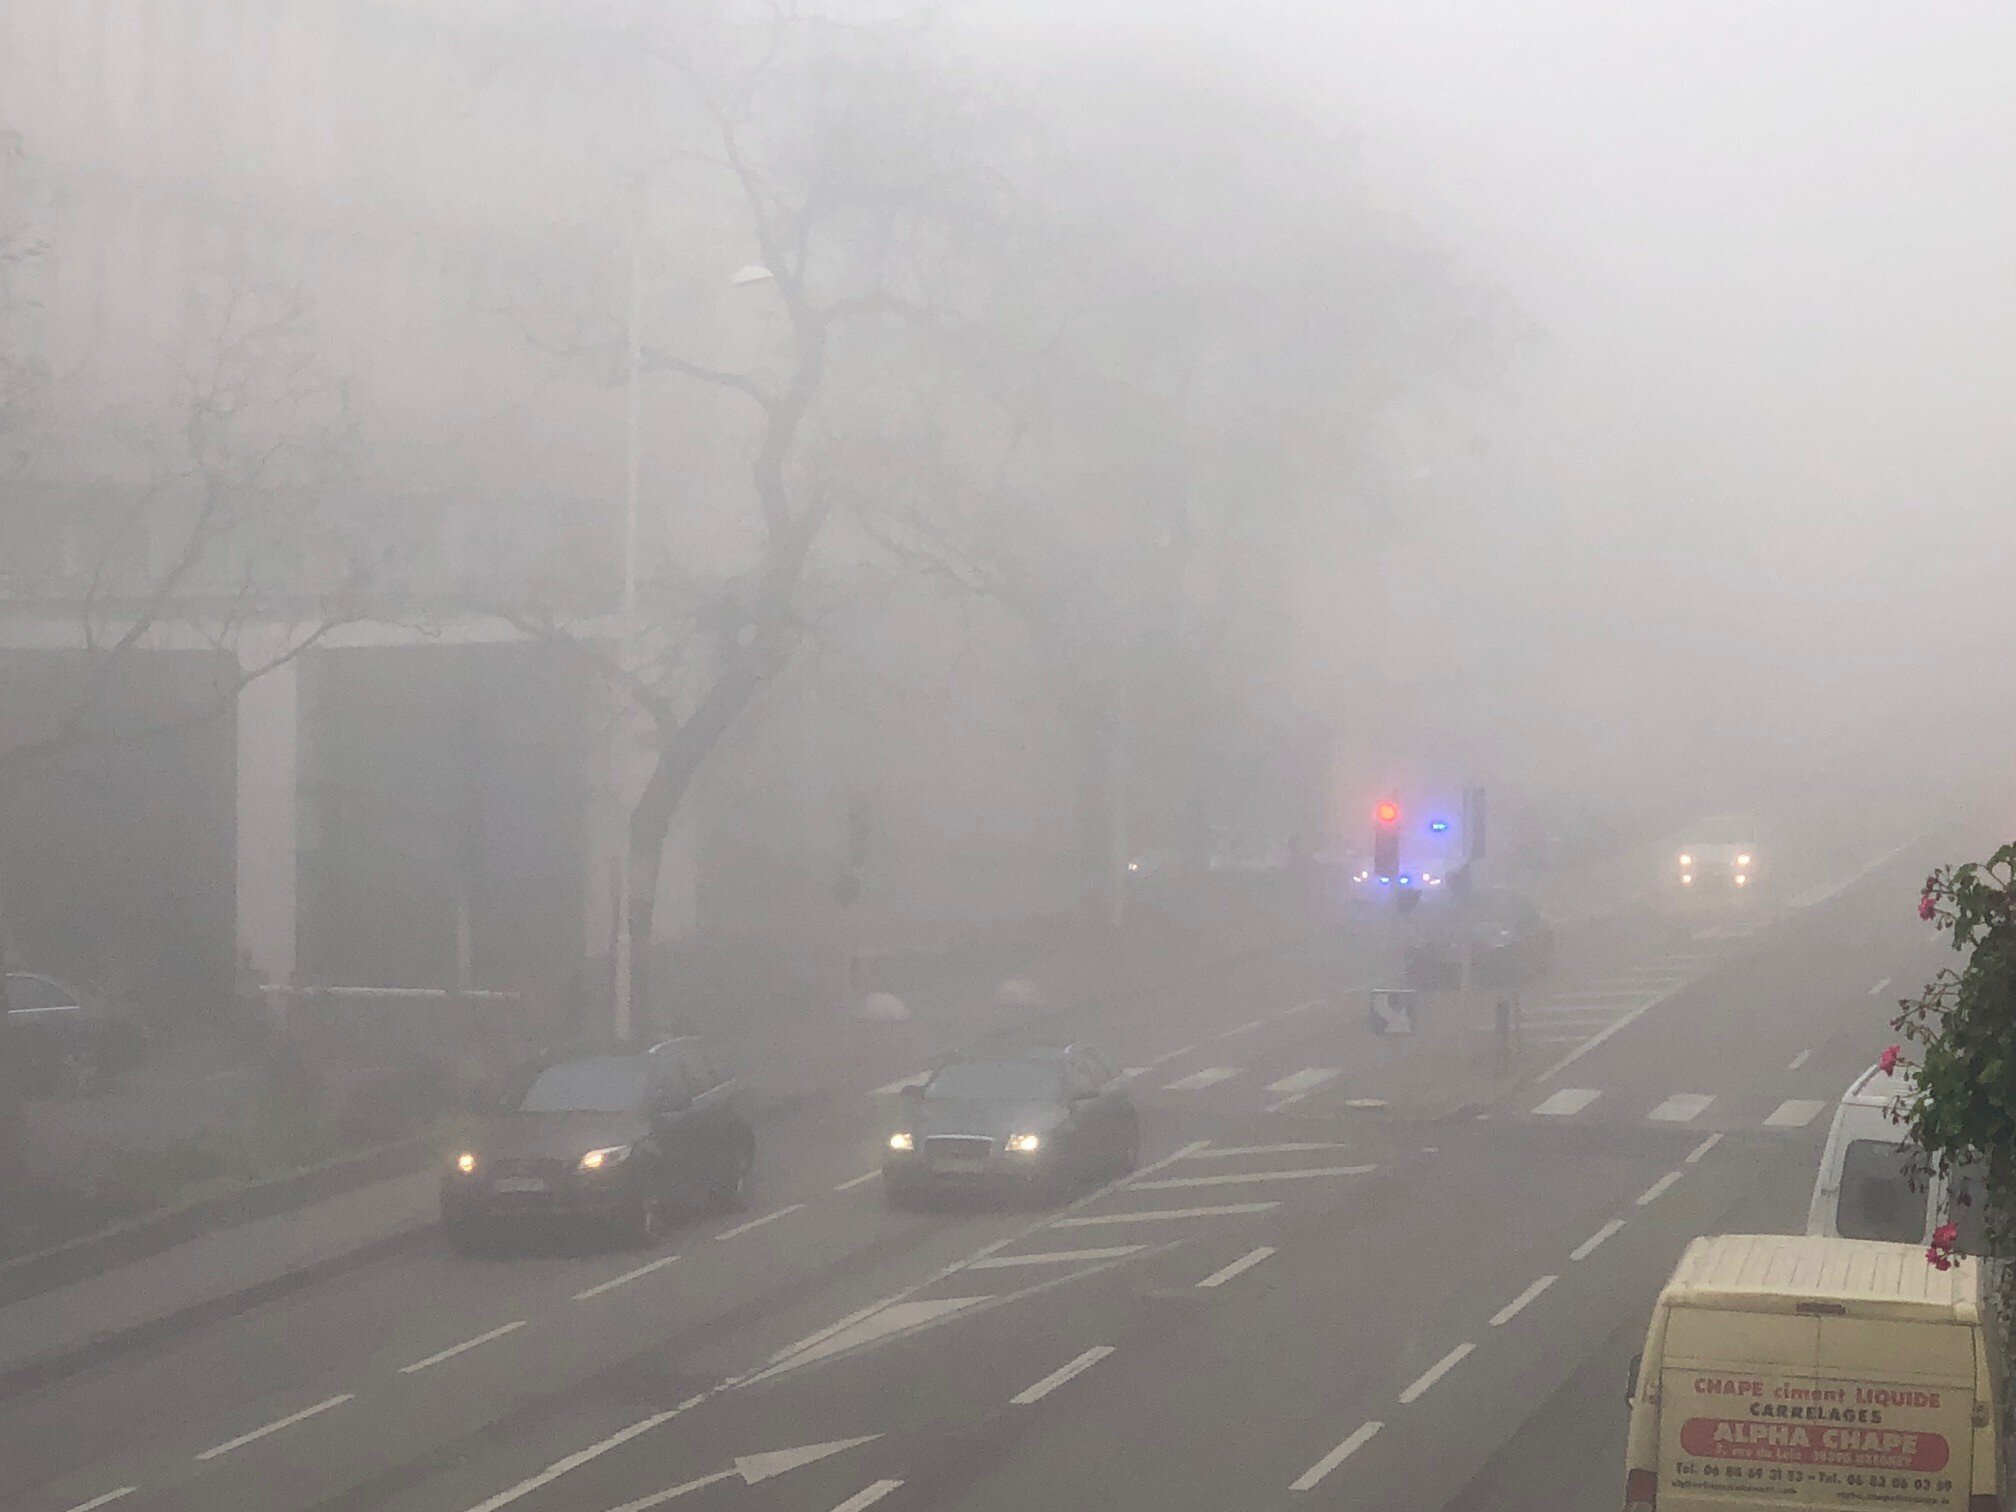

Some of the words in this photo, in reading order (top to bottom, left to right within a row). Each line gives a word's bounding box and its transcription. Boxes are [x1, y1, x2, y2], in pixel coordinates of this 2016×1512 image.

[1694, 1377, 1763, 1397] CHAPE
[1774, 1382, 1845, 1403] ciment
[1856, 1388, 1941, 1408] LIQUIDE
[1749, 1402, 1882, 1424] CARRELAGES
[1713, 1422, 1810, 1447] ALPHA
[1822, 1429, 1918, 1454] CHAPE
[1703, 1464, 1720, 1476] 06
